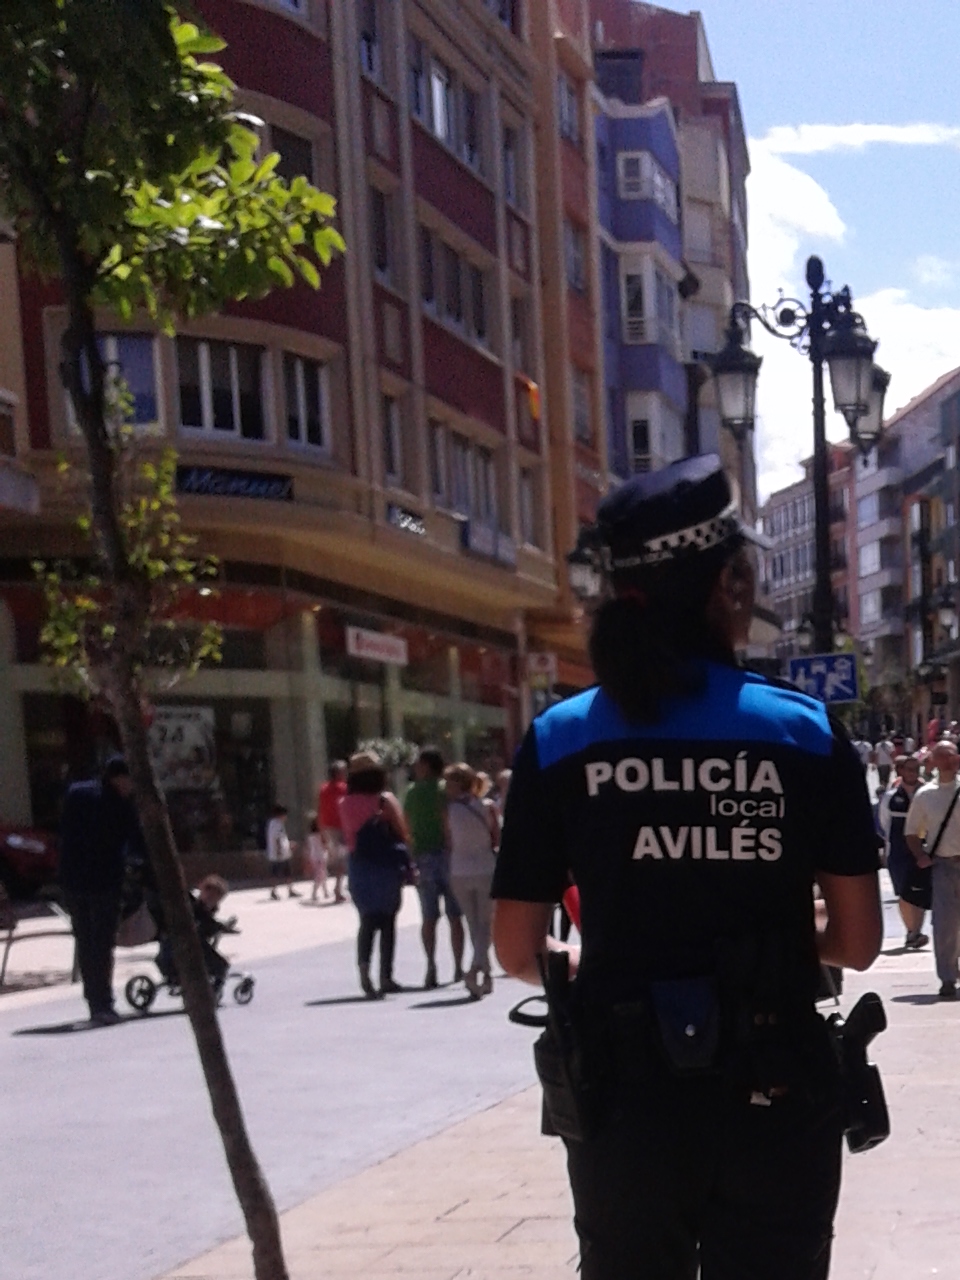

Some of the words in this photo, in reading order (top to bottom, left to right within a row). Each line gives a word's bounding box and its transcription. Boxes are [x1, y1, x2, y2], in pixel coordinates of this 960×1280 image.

[585, 751, 784, 797] POLICÍA
[710, 794, 785, 819] local
[632, 820, 783, 862] AVILÉS
